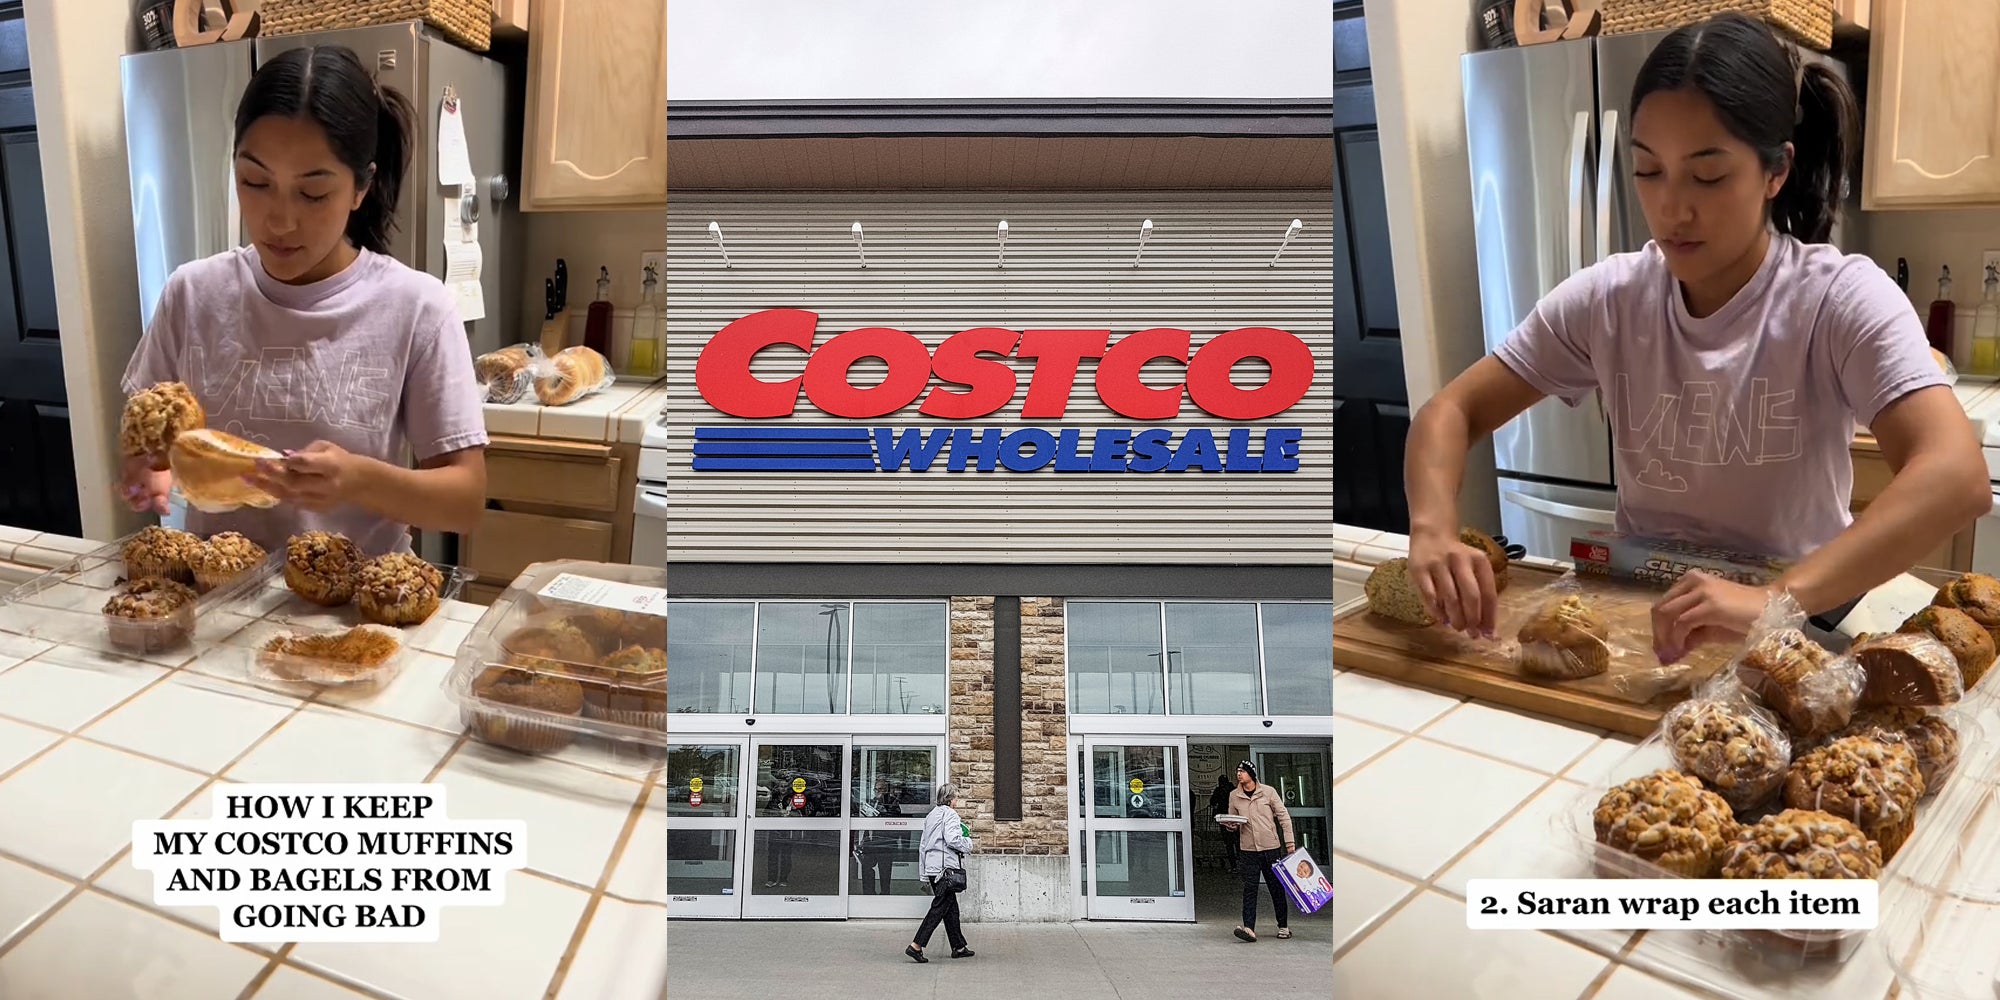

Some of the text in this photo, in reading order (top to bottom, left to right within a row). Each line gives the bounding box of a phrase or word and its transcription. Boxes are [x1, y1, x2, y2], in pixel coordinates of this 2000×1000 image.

[190, 346, 389, 433] VIEWS
[694, 308, 1315, 420] COSTCO
[873, 427, 1304, 473] WHOLESALE
[1616, 373, 1802, 465] VIEWS
